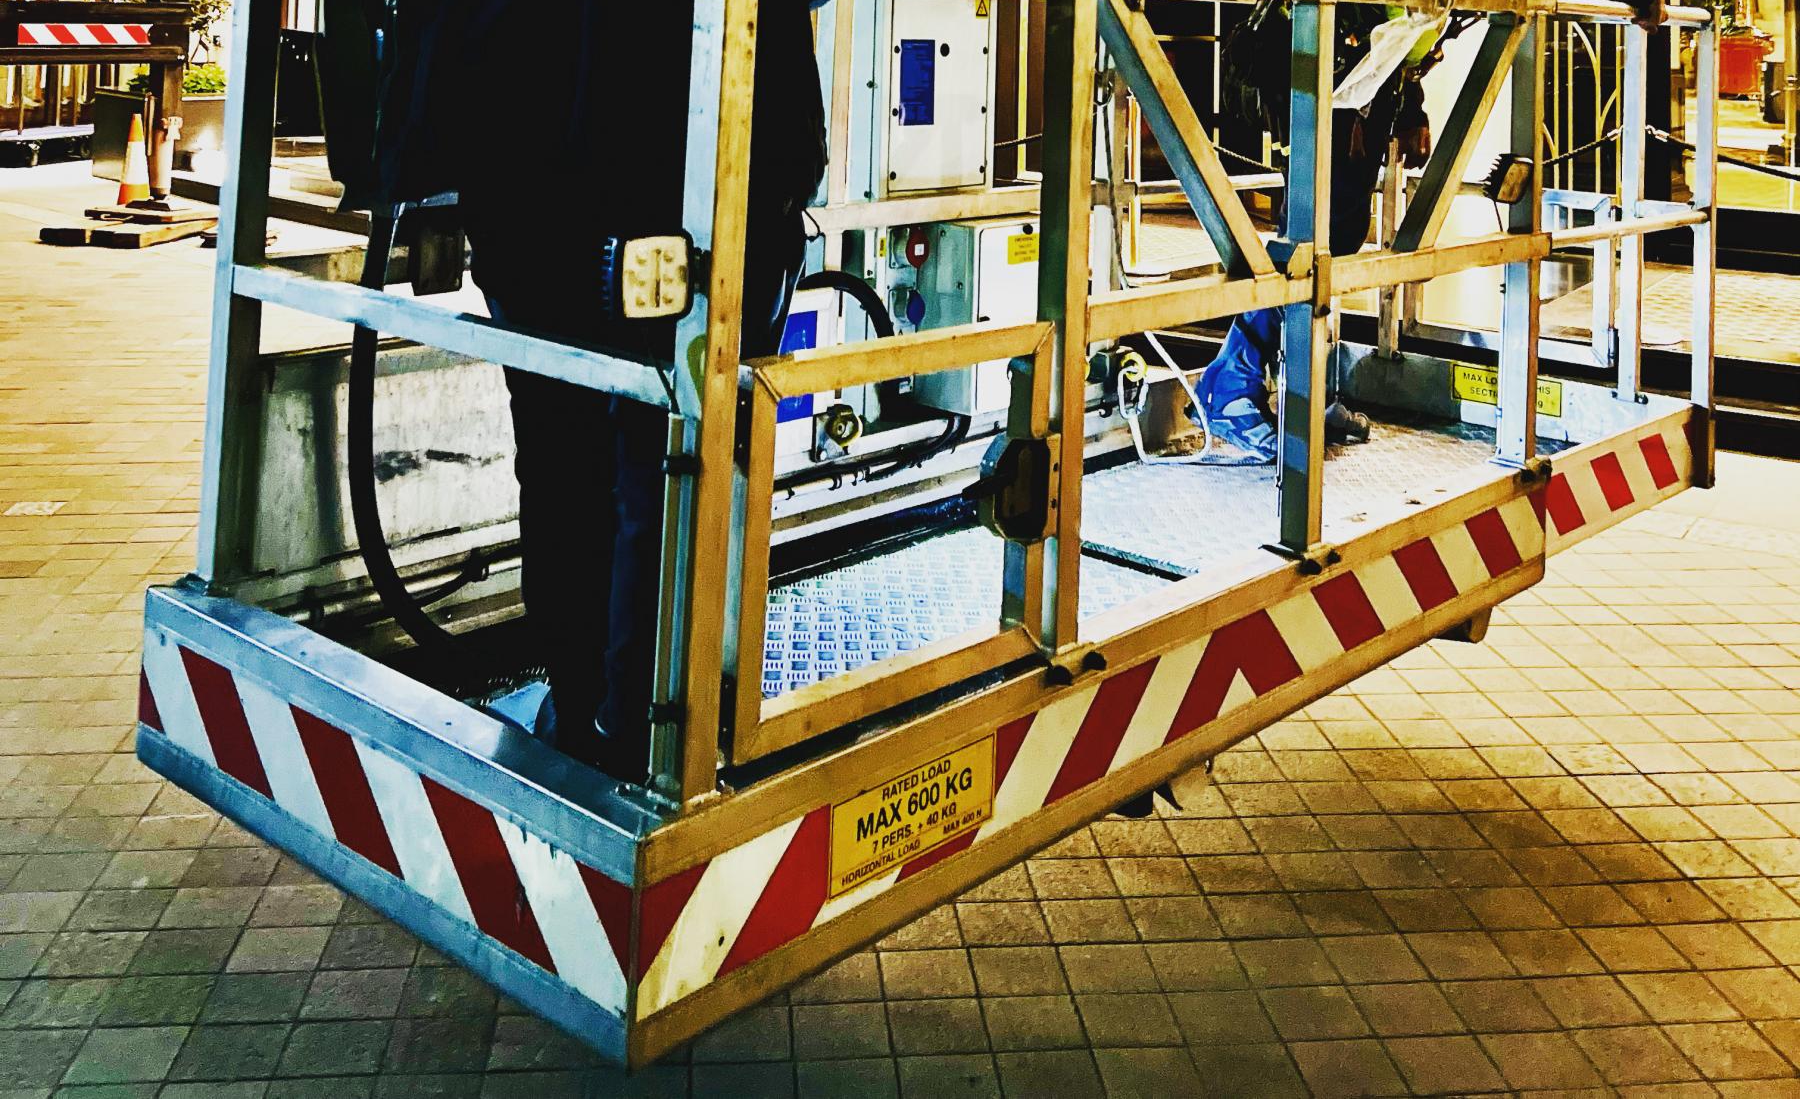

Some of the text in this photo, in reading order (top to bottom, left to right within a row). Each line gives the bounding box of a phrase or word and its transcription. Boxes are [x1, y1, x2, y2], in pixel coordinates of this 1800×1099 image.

[1463, 372, 1483, 383] MAX
[1485, 376, 1498, 386] LO
[1470, 386, 1498, 399] SECTI
[881, 759, 951, 802] RATED LOAD
[856, 767, 972, 842] MAX 600 KG
[872, 840, 879, 854] 7
[881, 823, 915, 849] PERS.
[926, 811, 939, 826] 40
[941, 802, 957, 820] KG
[841, 851, 896, 886] HORIZONTAL
[898, 839, 920, 858] LOAD
[943, 819, 961, 835] MAX
